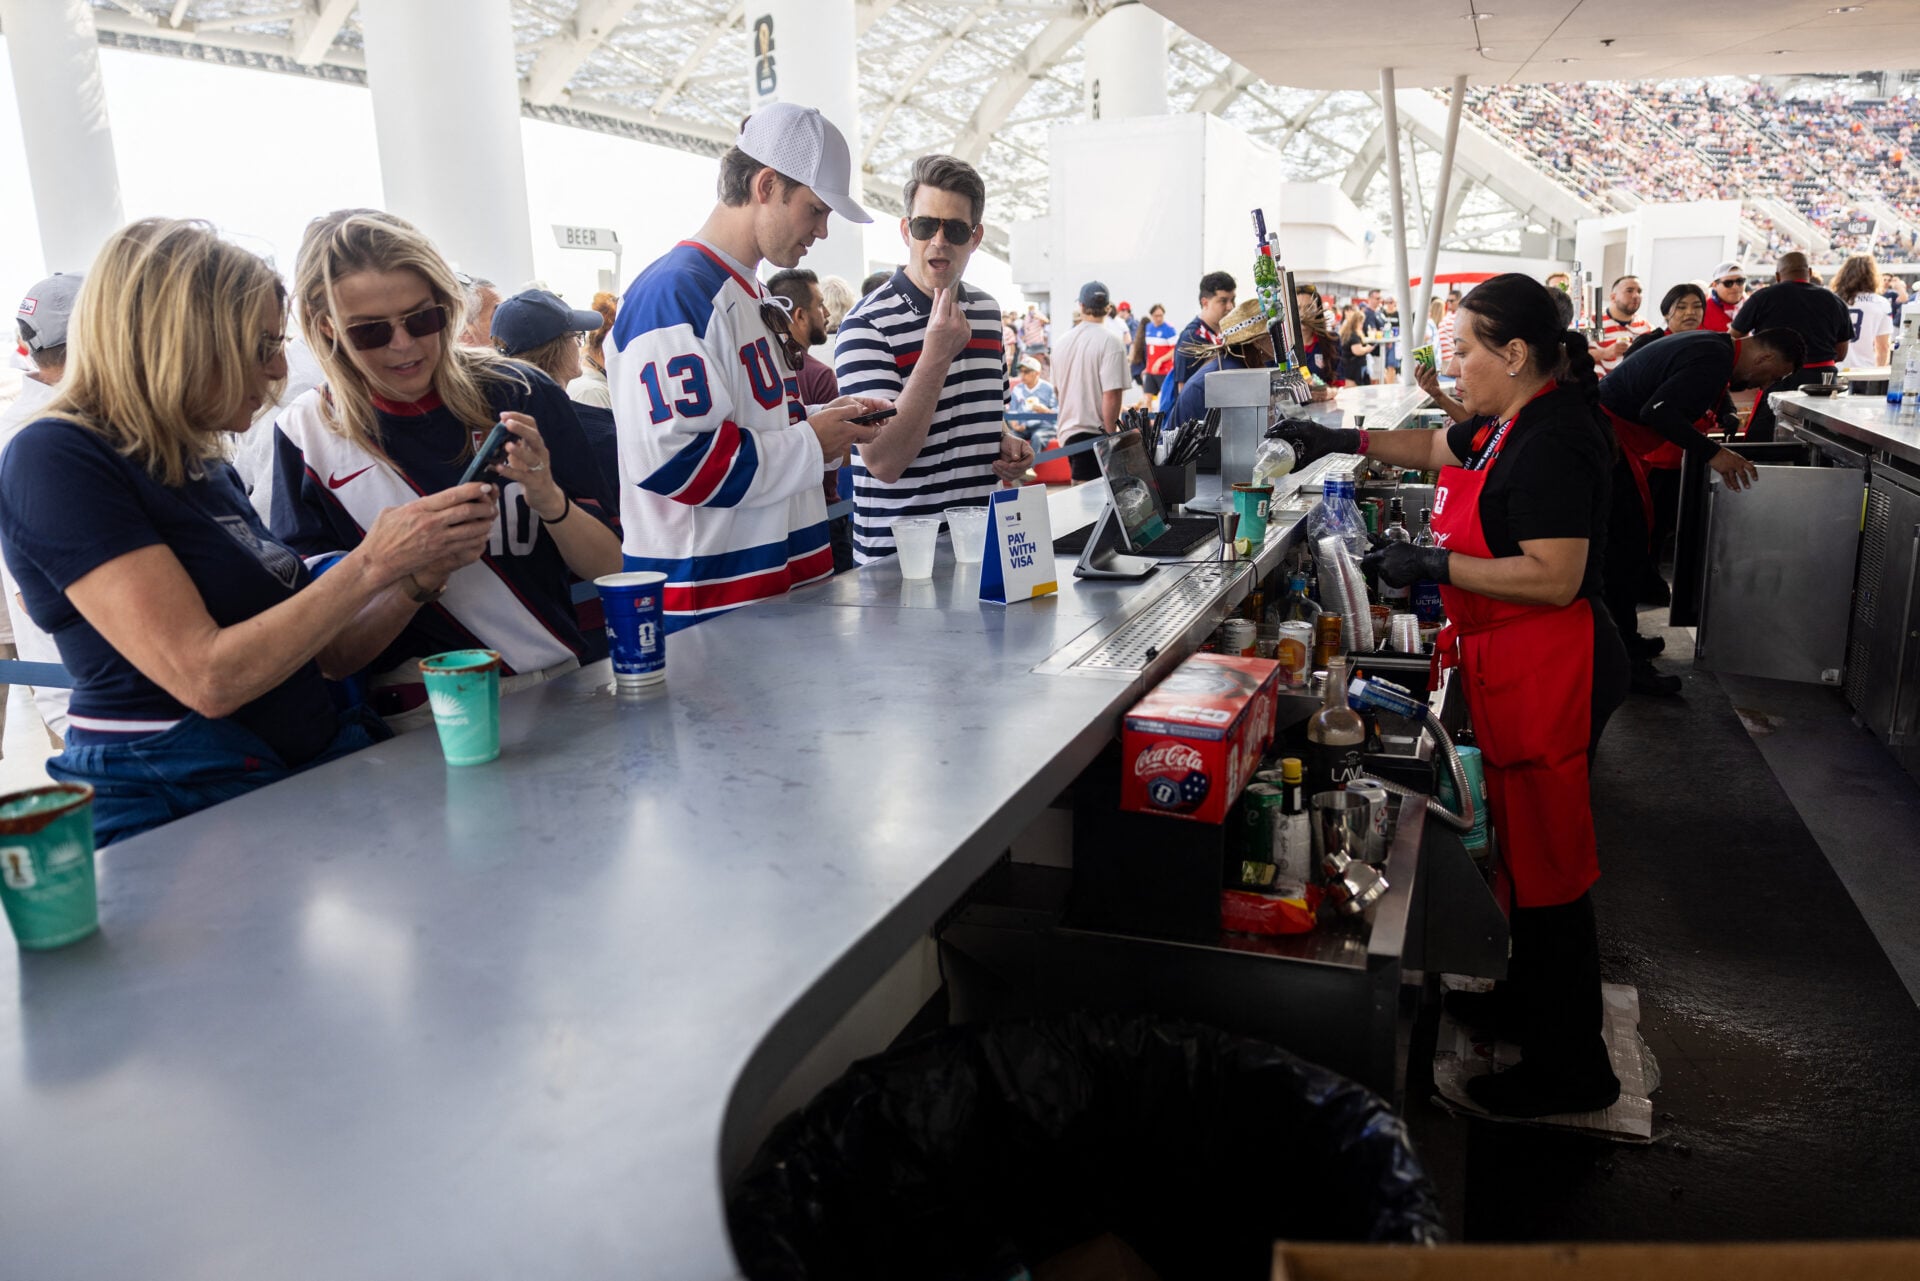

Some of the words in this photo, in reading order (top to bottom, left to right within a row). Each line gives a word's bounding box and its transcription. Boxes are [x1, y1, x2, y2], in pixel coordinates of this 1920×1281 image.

[567, 228, 597, 246] BEER
[902, 293, 920, 315] RLX
[640, 353, 713, 425] 13
[1482, 433, 1501, 459] WORLD
[1008, 532, 1026, 545] PAY
[1009, 542, 1037, 557] WITH
[1011, 555, 1034, 569] VISA
